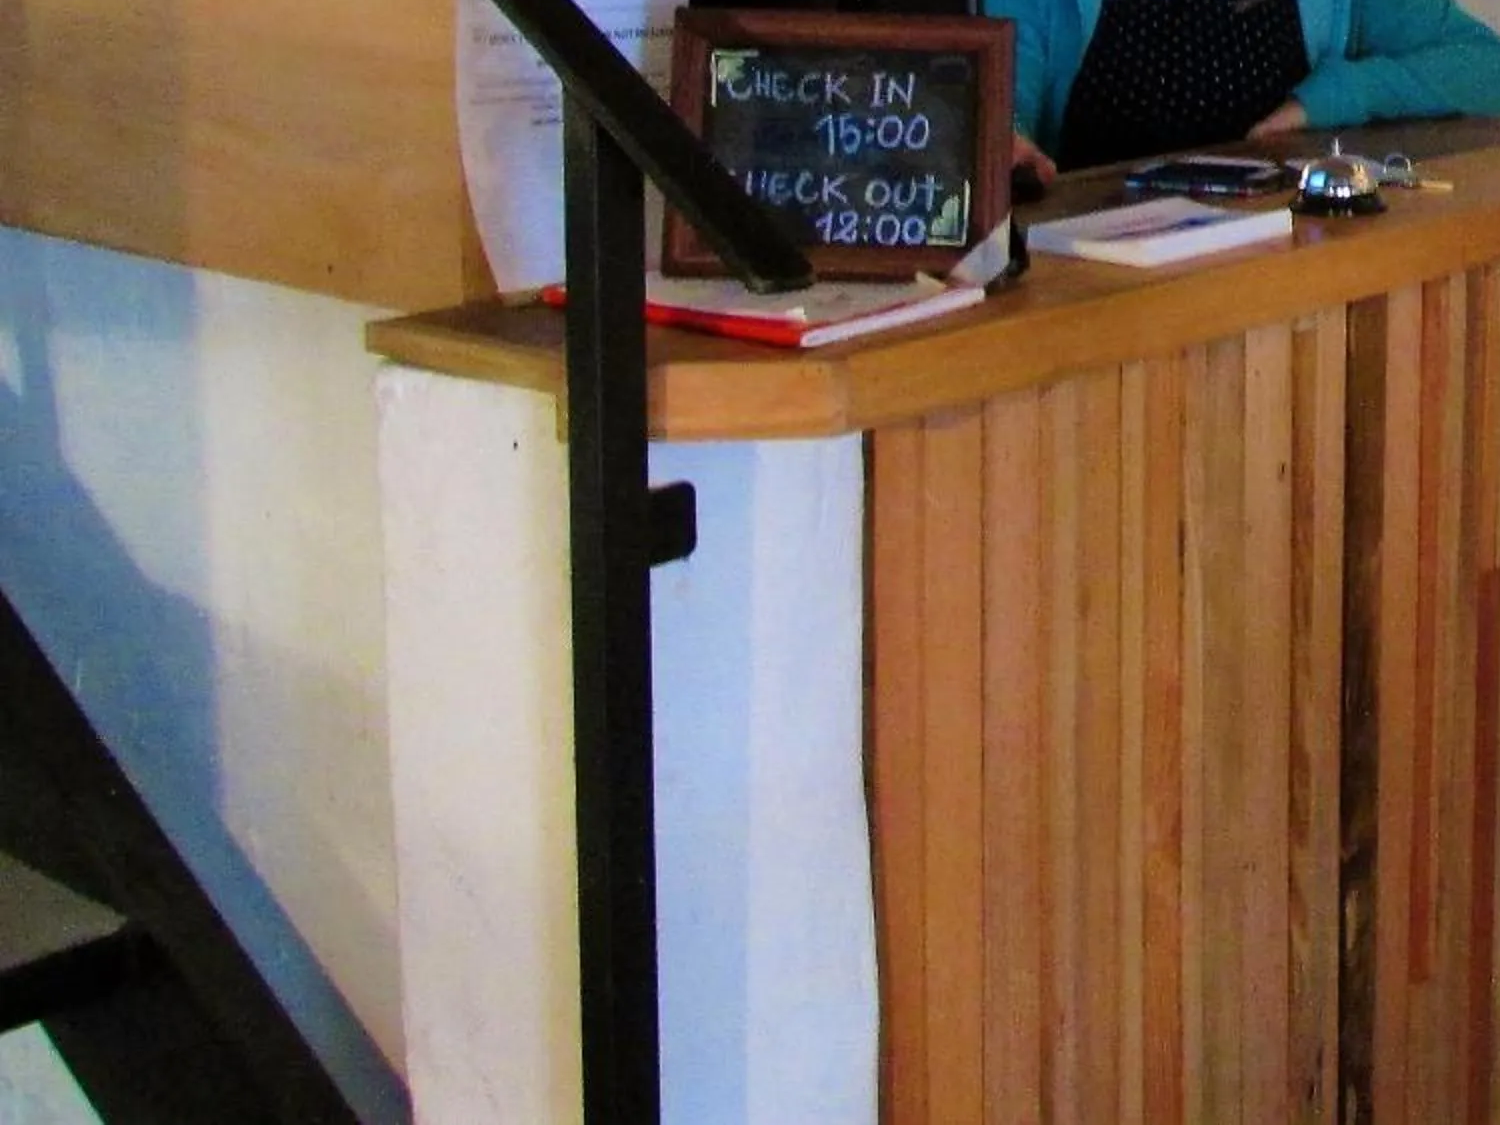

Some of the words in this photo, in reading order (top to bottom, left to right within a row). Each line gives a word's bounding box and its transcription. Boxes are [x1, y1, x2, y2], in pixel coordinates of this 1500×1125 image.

[726, 68, 851, 104] CHECK
[870, 72, 915, 110] IN
[816, 113, 930, 157] 15:00
[731, 169, 849, 205] HECK
